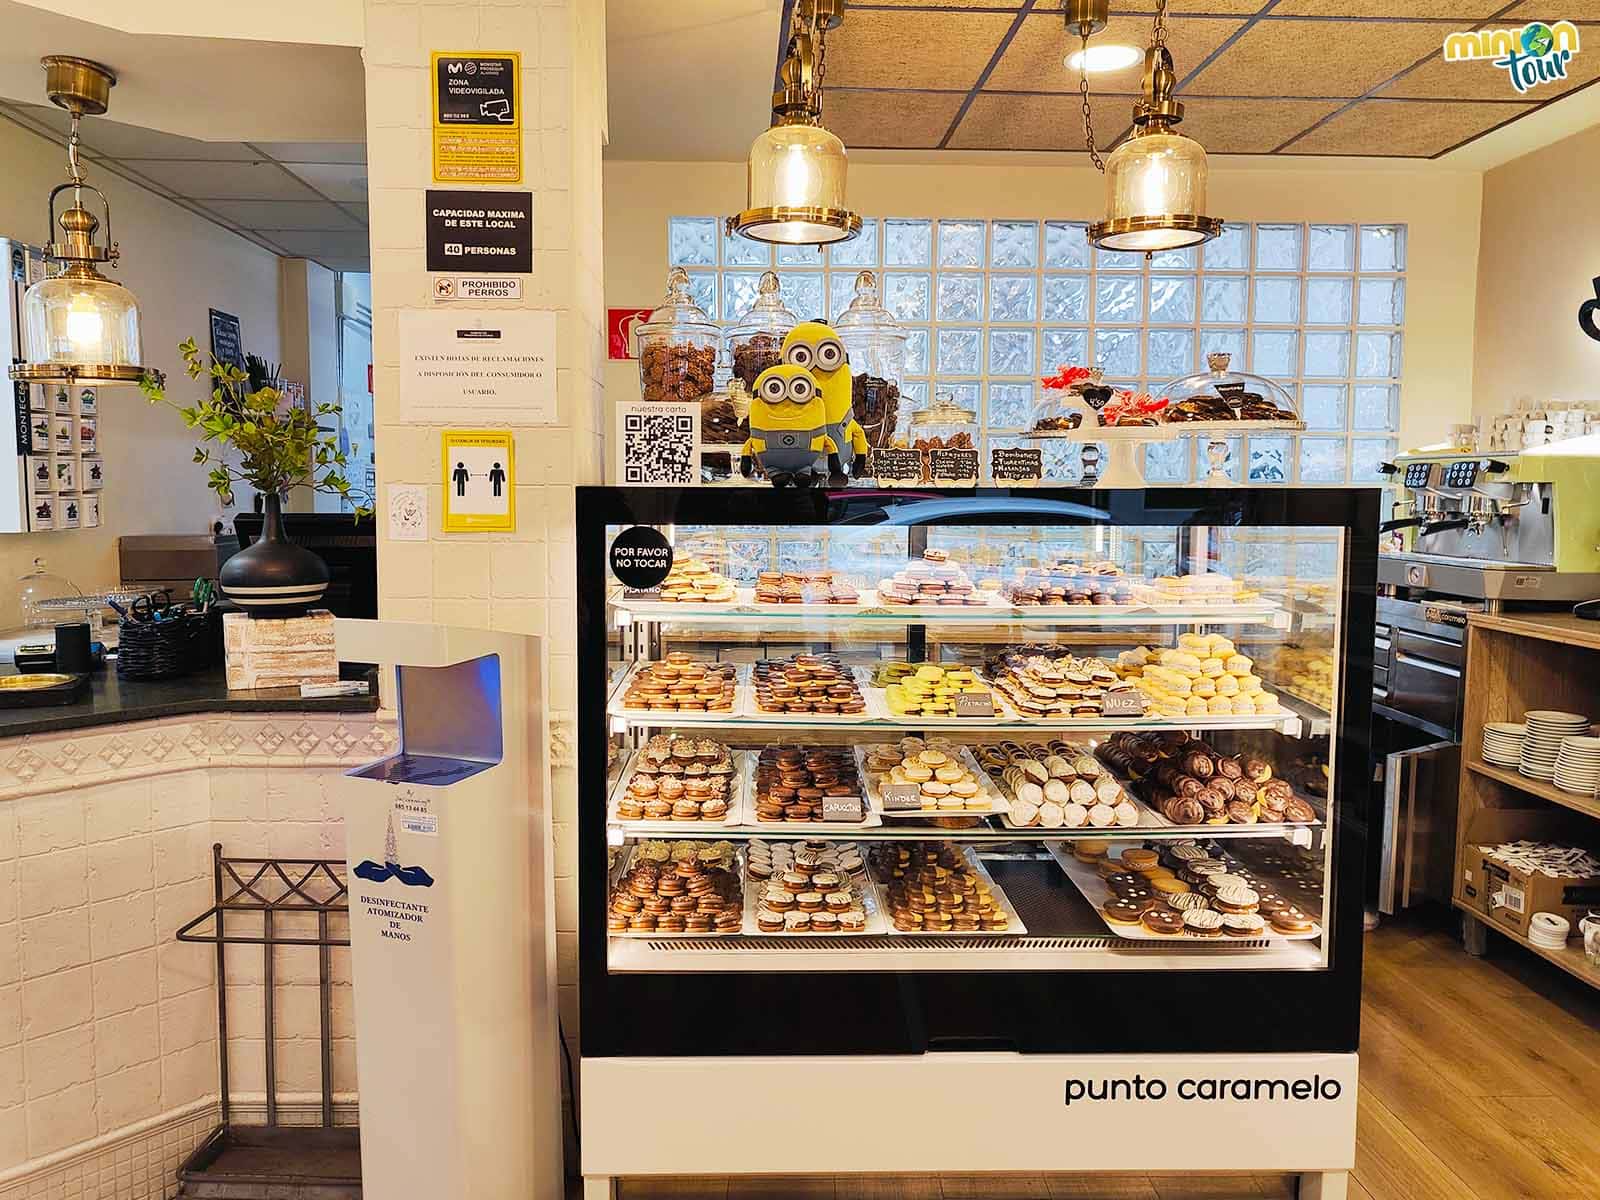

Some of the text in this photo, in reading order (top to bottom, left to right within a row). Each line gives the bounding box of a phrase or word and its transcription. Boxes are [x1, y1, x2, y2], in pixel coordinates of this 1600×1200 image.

[448, 87, 505, 95] VIDEOVIGILADA
[433, 209, 525, 219] CAPACIDAD MAXIMA
[445, 219, 516, 229] DE ESTE LOCAL
[446, 245, 517, 256] 40 PERSONAS
[462, 280, 516, 289] PROHIBIDO
[468, 288, 509, 297] PERROS
[665, 406, 687, 414] carta
[614, 547, 669, 557] POR FAVOR
[616, 558, 667, 568] NO TOCAR
[360, 895, 430, 914] DESINFECTANTE
[366, 907, 424, 923] ATOMIZADOR
[389, 920, 401, 930] DE
[380, 929, 411, 942] MANOS
[1065, 1074, 1342, 1106] punto caramelo
